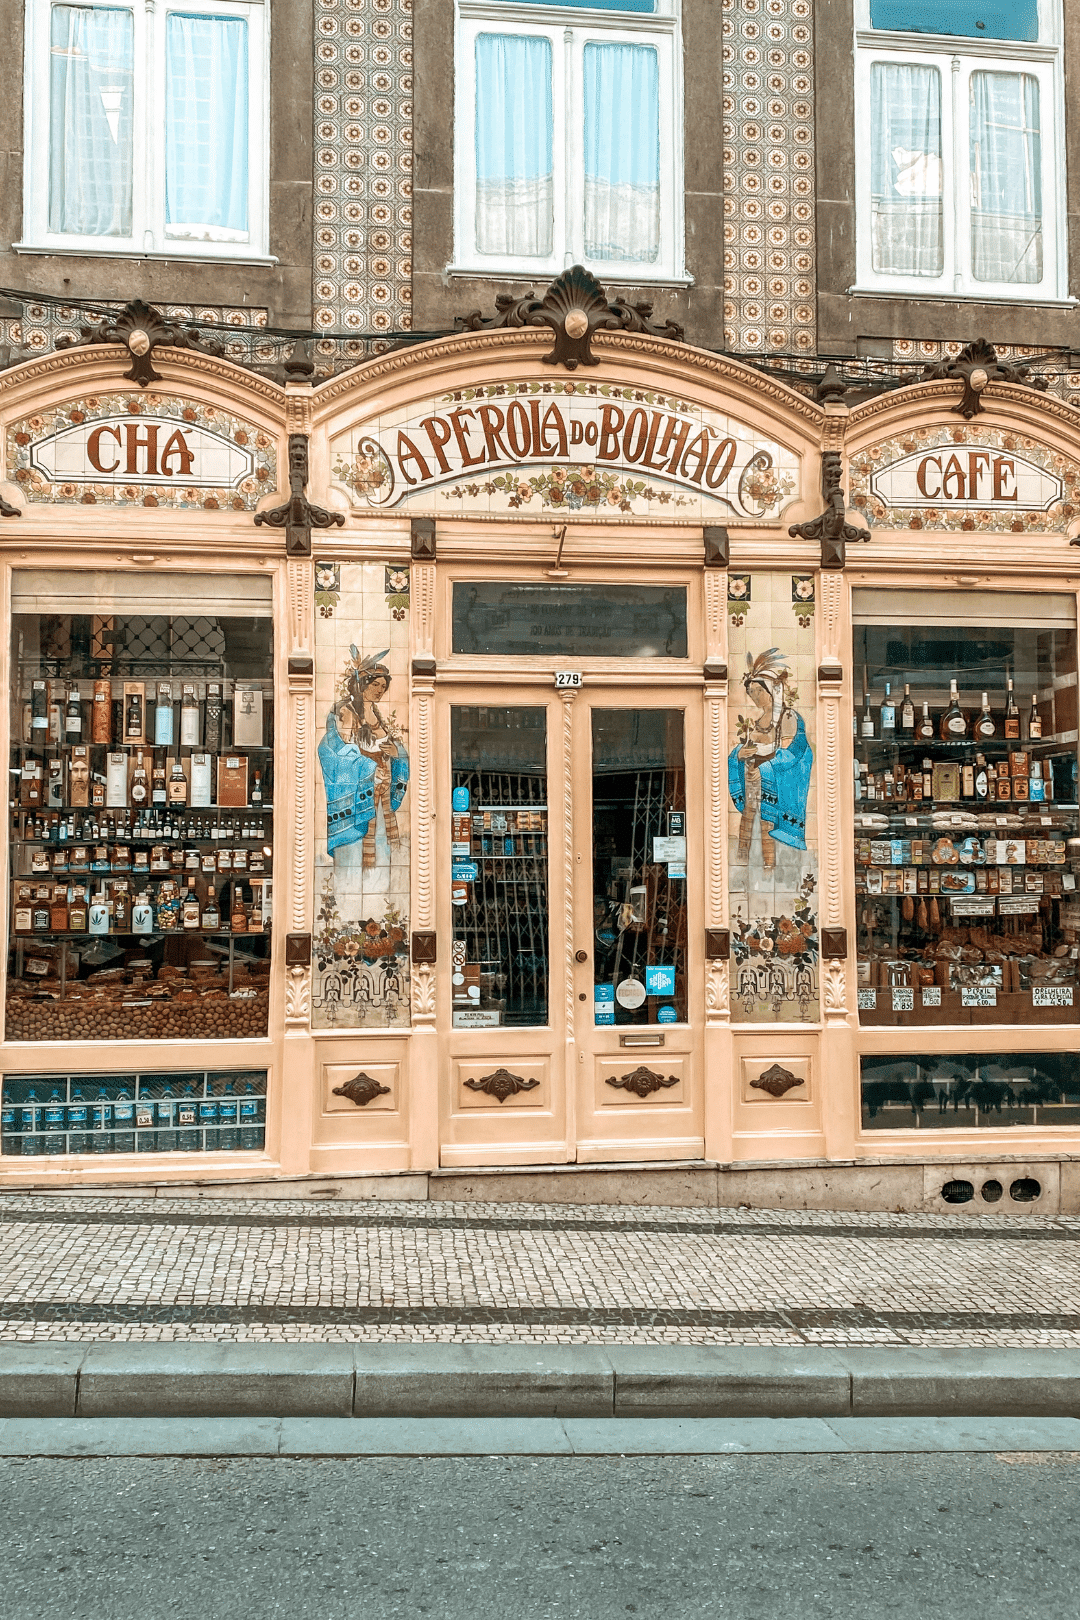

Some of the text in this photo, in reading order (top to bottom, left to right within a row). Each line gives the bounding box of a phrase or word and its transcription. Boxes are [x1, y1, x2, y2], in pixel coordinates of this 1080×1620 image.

[87, 423, 195, 476] CHÁ
[397, 399, 738, 489] A PÉROLA DO BOLHÃO
[916, 452, 1018, 501] CAFÉ
[544, 625, 562, 636] ANOS
[558, 673, 579, 685] 279
[1034, 987, 1071, 995] ORELHEIRA
